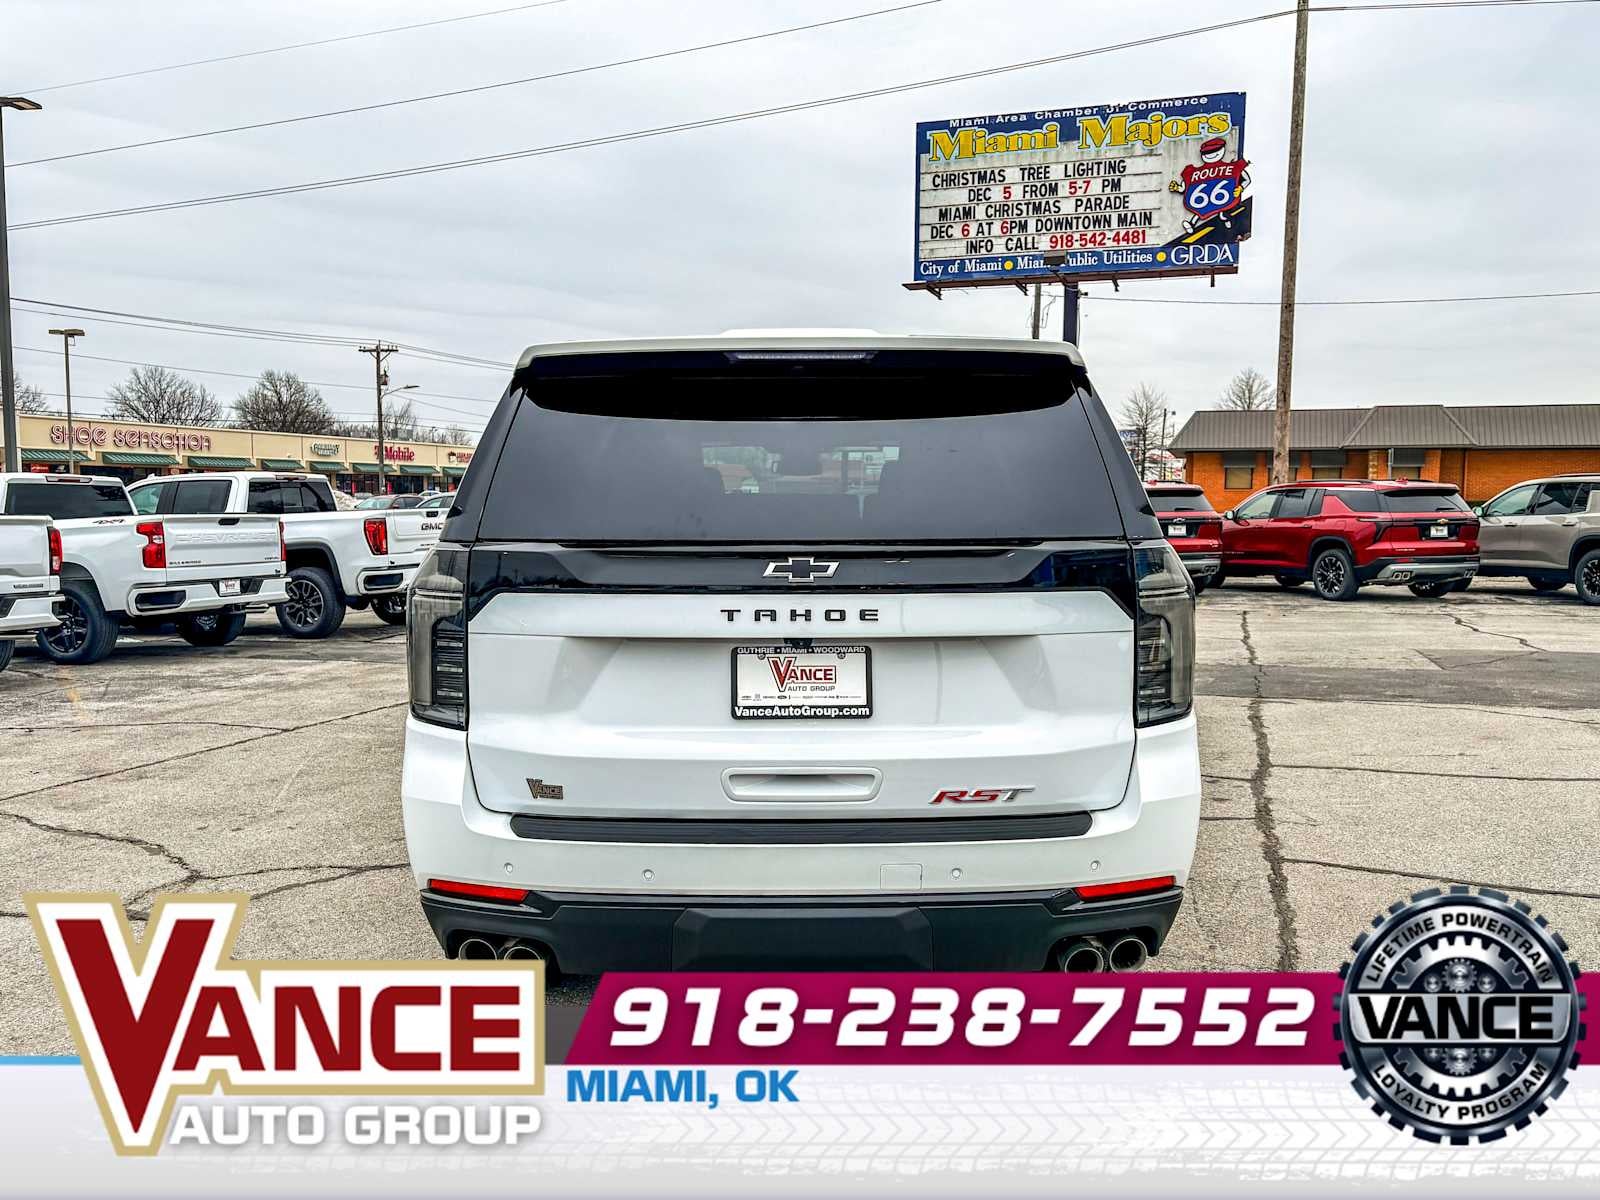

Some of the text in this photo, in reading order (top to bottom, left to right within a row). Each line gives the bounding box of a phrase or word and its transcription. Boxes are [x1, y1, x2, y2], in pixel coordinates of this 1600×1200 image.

[950, 116, 989, 128] Miami
[996, 113, 1027, 124] Area
[1034, 106, 1099, 120] Chamber
[1128, 96, 1208, 111] Commerce
[928, 114, 1231, 162] Miami Majors
[932, 160, 1127, 188] CHRISTMAS TREE LIGHTING
[1191, 165, 1234, 182] ROUTE
[968, 178, 1121, 203] DEC 5 FROM 5-7 PM
[1189, 180, 1231, 209] 66
[939, 195, 1130, 222] MIAMI CHRISTMAS PARADE
[931, 211, 1153, 239] DEC 6 AT 6PM DOWNTOWN MAIN
[966, 229, 1147, 254] INFO CALL 918-542-4481
[920, 244, 1234, 278] City of Miami Mia ublic Utilities GRDA
[421, 522, 447, 531] GMC
[720, 609, 879, 622] TAHOE
[768, 657, 836, 692] VANCE
[735, 706, 870, 718] VanceAutoGroup.com
[928, 785, 1036, 804] RST
